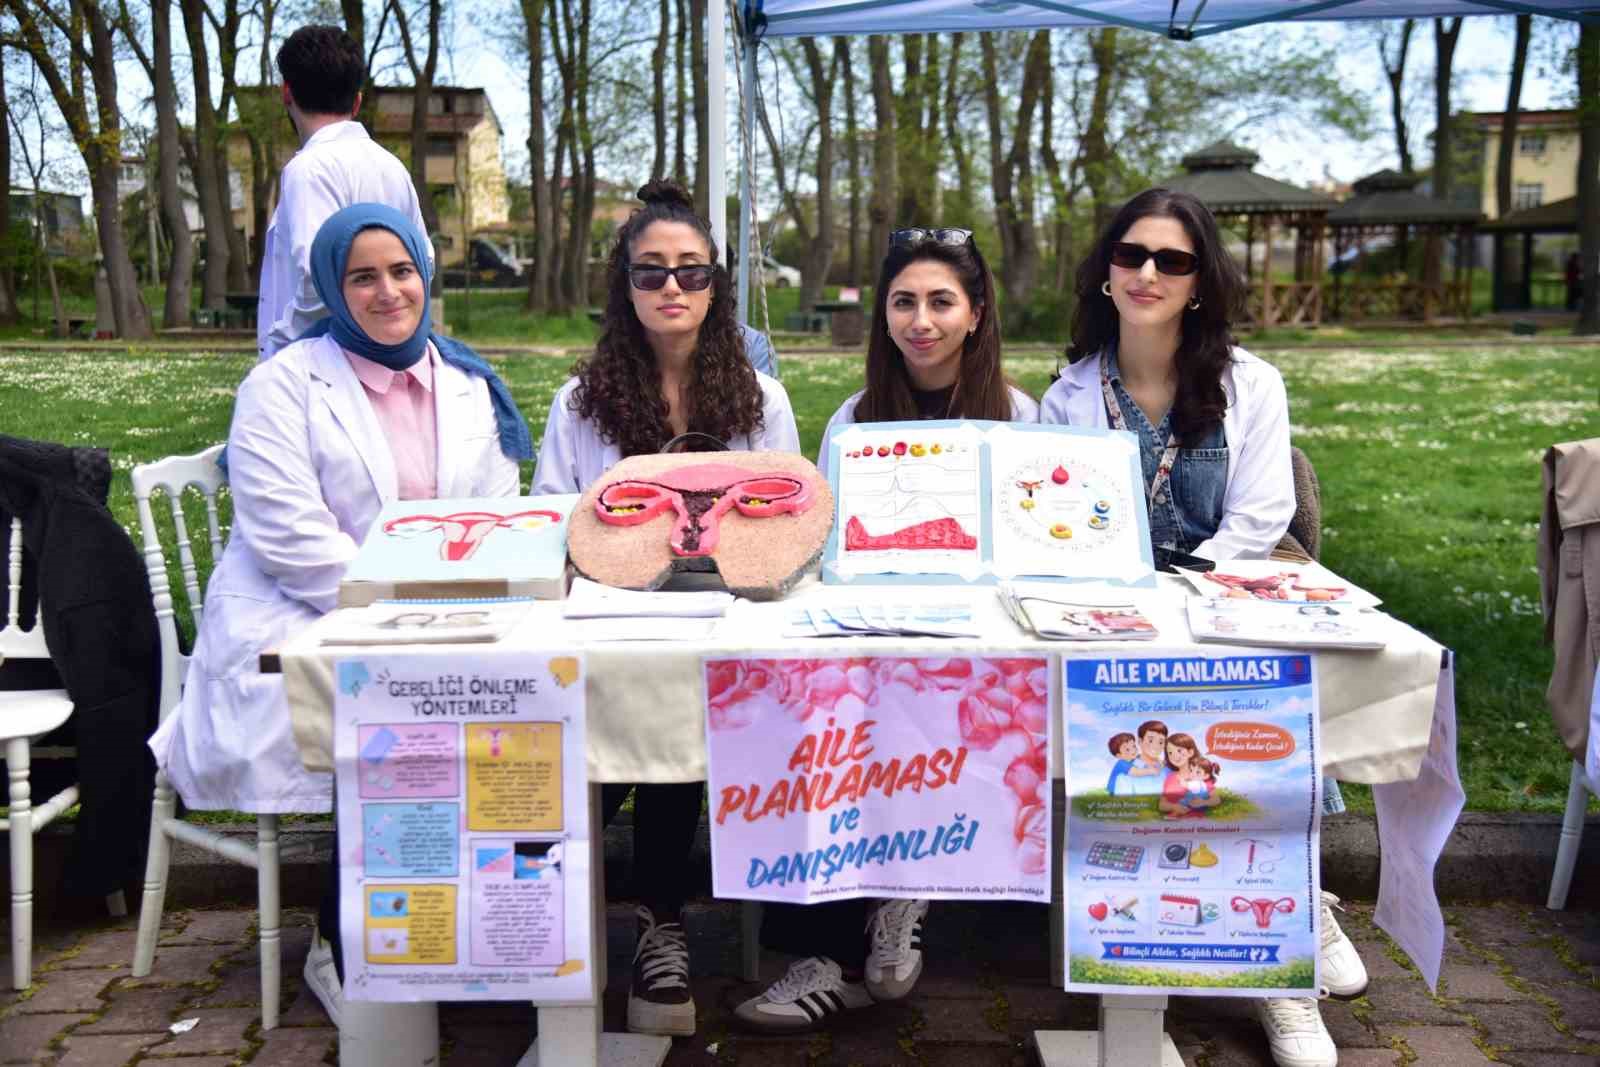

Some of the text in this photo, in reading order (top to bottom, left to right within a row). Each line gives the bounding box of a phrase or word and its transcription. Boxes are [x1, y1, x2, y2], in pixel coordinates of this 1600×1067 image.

[389, 675, 538, 697] GEBELİĞİ ÖNLEME
[1094, 659, 1281, 684] AİLE PLANLAMASI
[411, 695, 517, 716] YÖNTEMLERİ
[788, 716, 879, 773] AİLE
[714, 747, 969, 826] PLANLAMASI
[829, 806, 861, 835] ve
[746, 813, 980, 889] DANIŞMANLIĞI
